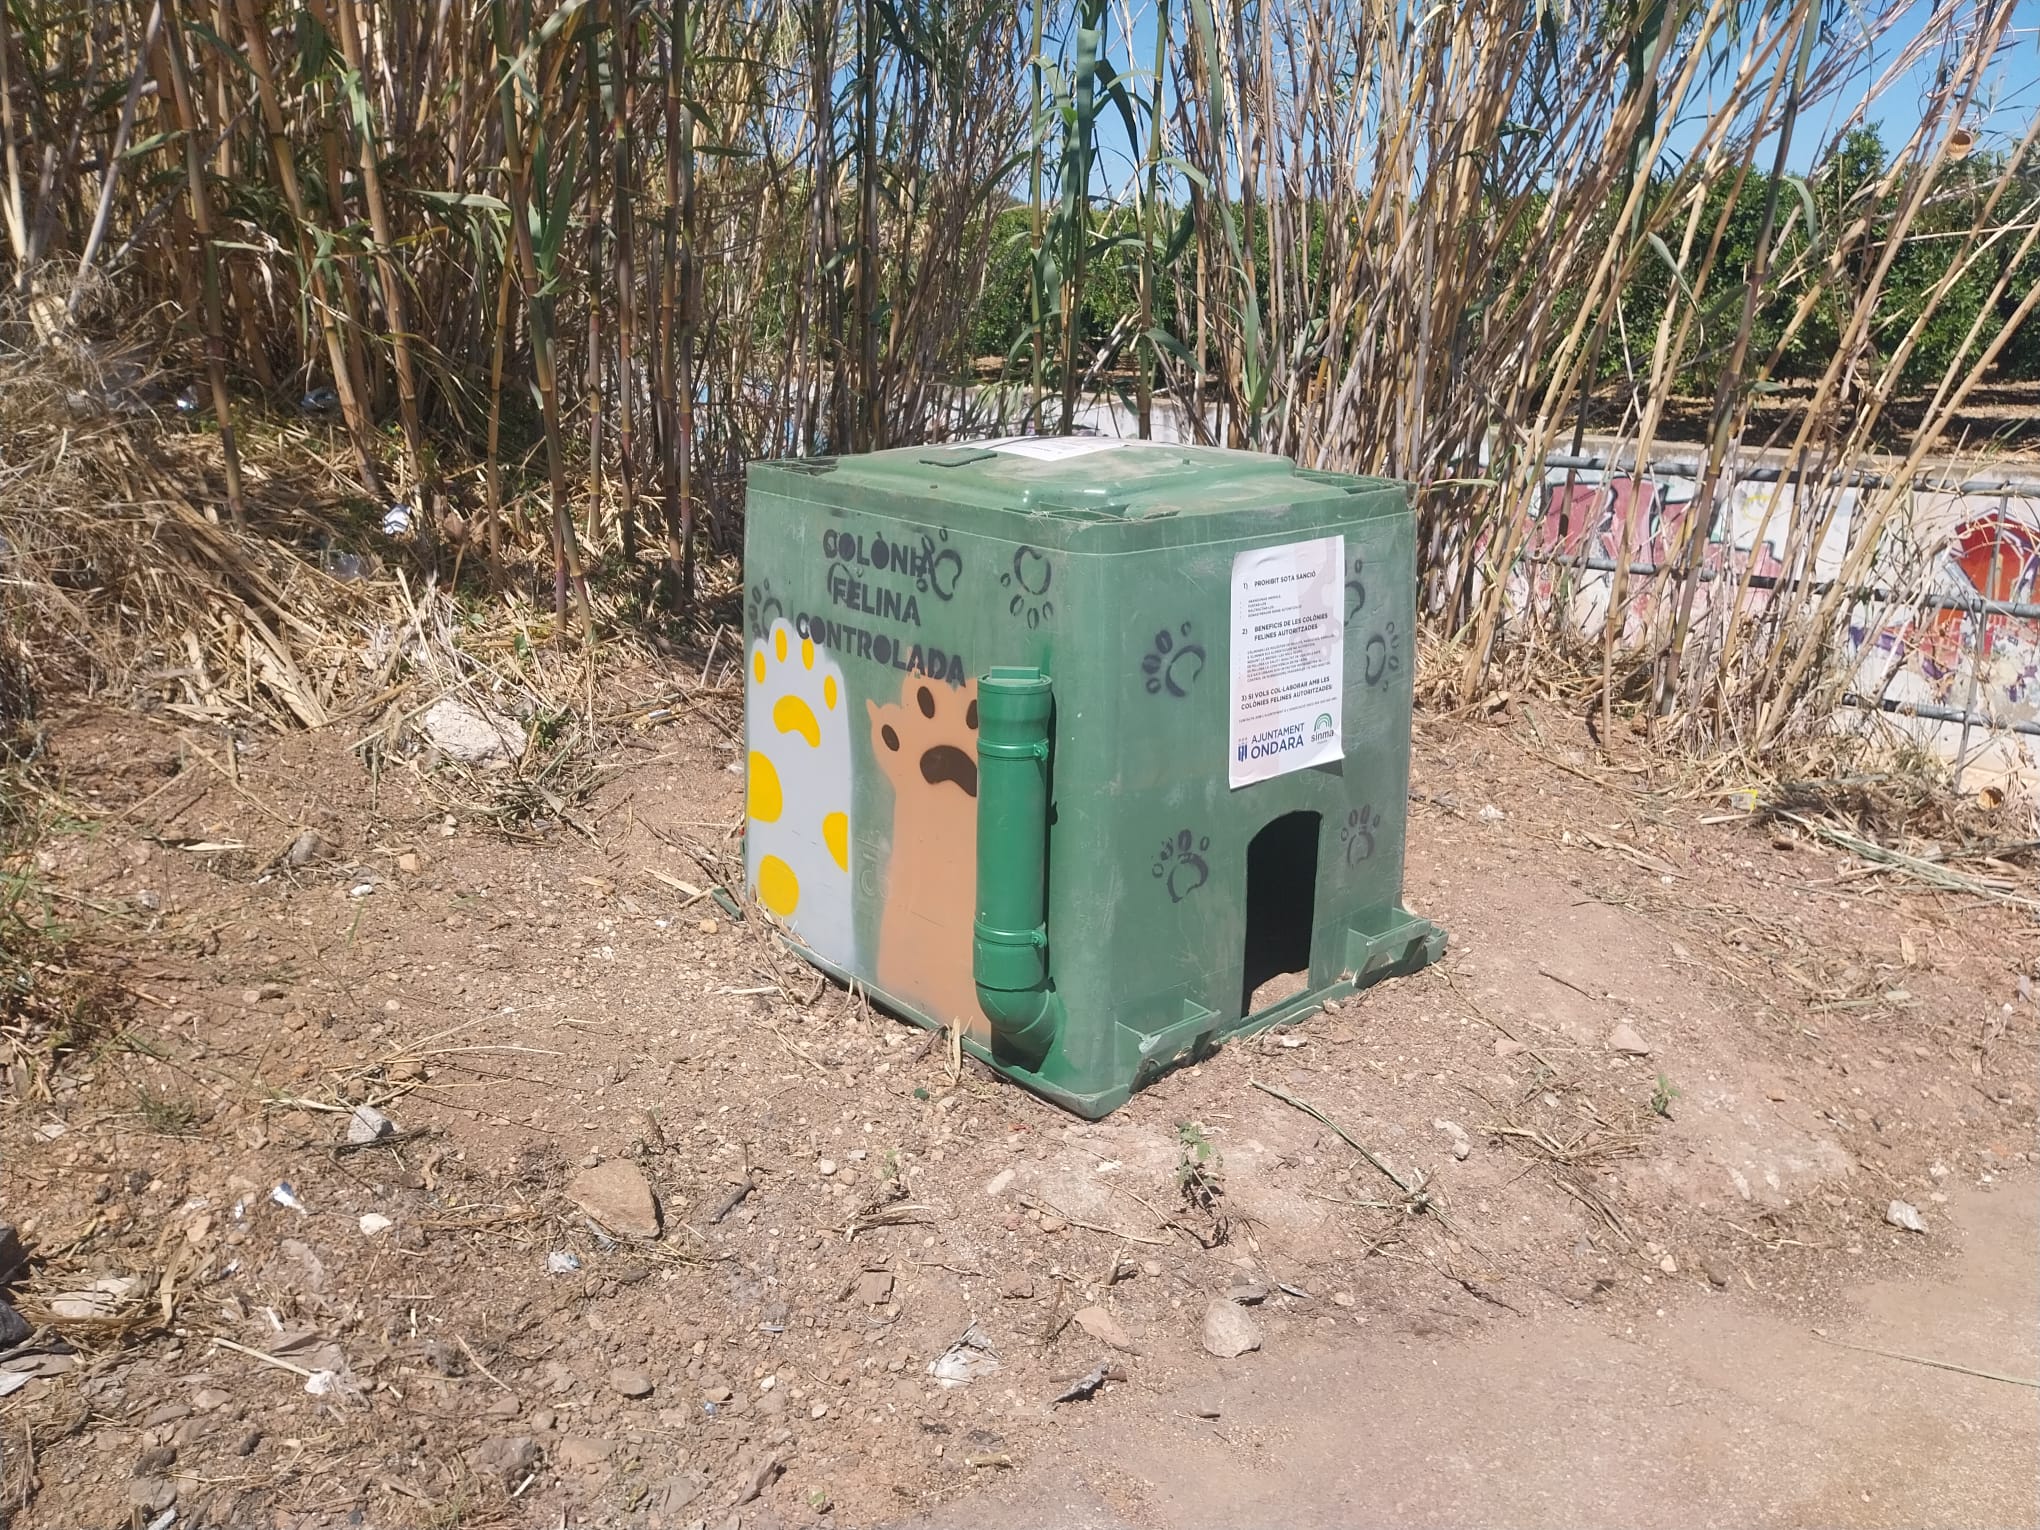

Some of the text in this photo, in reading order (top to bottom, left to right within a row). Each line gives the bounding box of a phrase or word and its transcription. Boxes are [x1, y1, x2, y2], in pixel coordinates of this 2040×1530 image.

[1254, 577, 1279, 587] PROHIBIT
[1280, 574, 1295, 583] SOTA
[1296, 570, 1316, 580] SANCIÓ
[833, 576, 921, 627] FELINA
[1254, 622, 1283, 632] BENEFICIS
[1292, 617, 1302, 625] LES
[1302, 613, 1328, 623] COLÒNIES
[1254, 624, 1318, 641] FELINES AUTORITZADES
[796, 612, 967, 688] CONTROLADA
[1241, 694, 1247, 702] 3)
[1254, 690, 1269, 698] VOLS
[1309, 678, 1320, 686] AMB
[1320, 676, 1330, 684] LES
[1241, 699, 1269, 710] COLÒNIES
[1270, 693, 1292, 704] FELINES
[1293, 685, 1332, 698] AUTORITZADES
[1251, 723, 1305, 744] AJUNTAMENT
[1250, 734, 1304, 759] ONDARA
